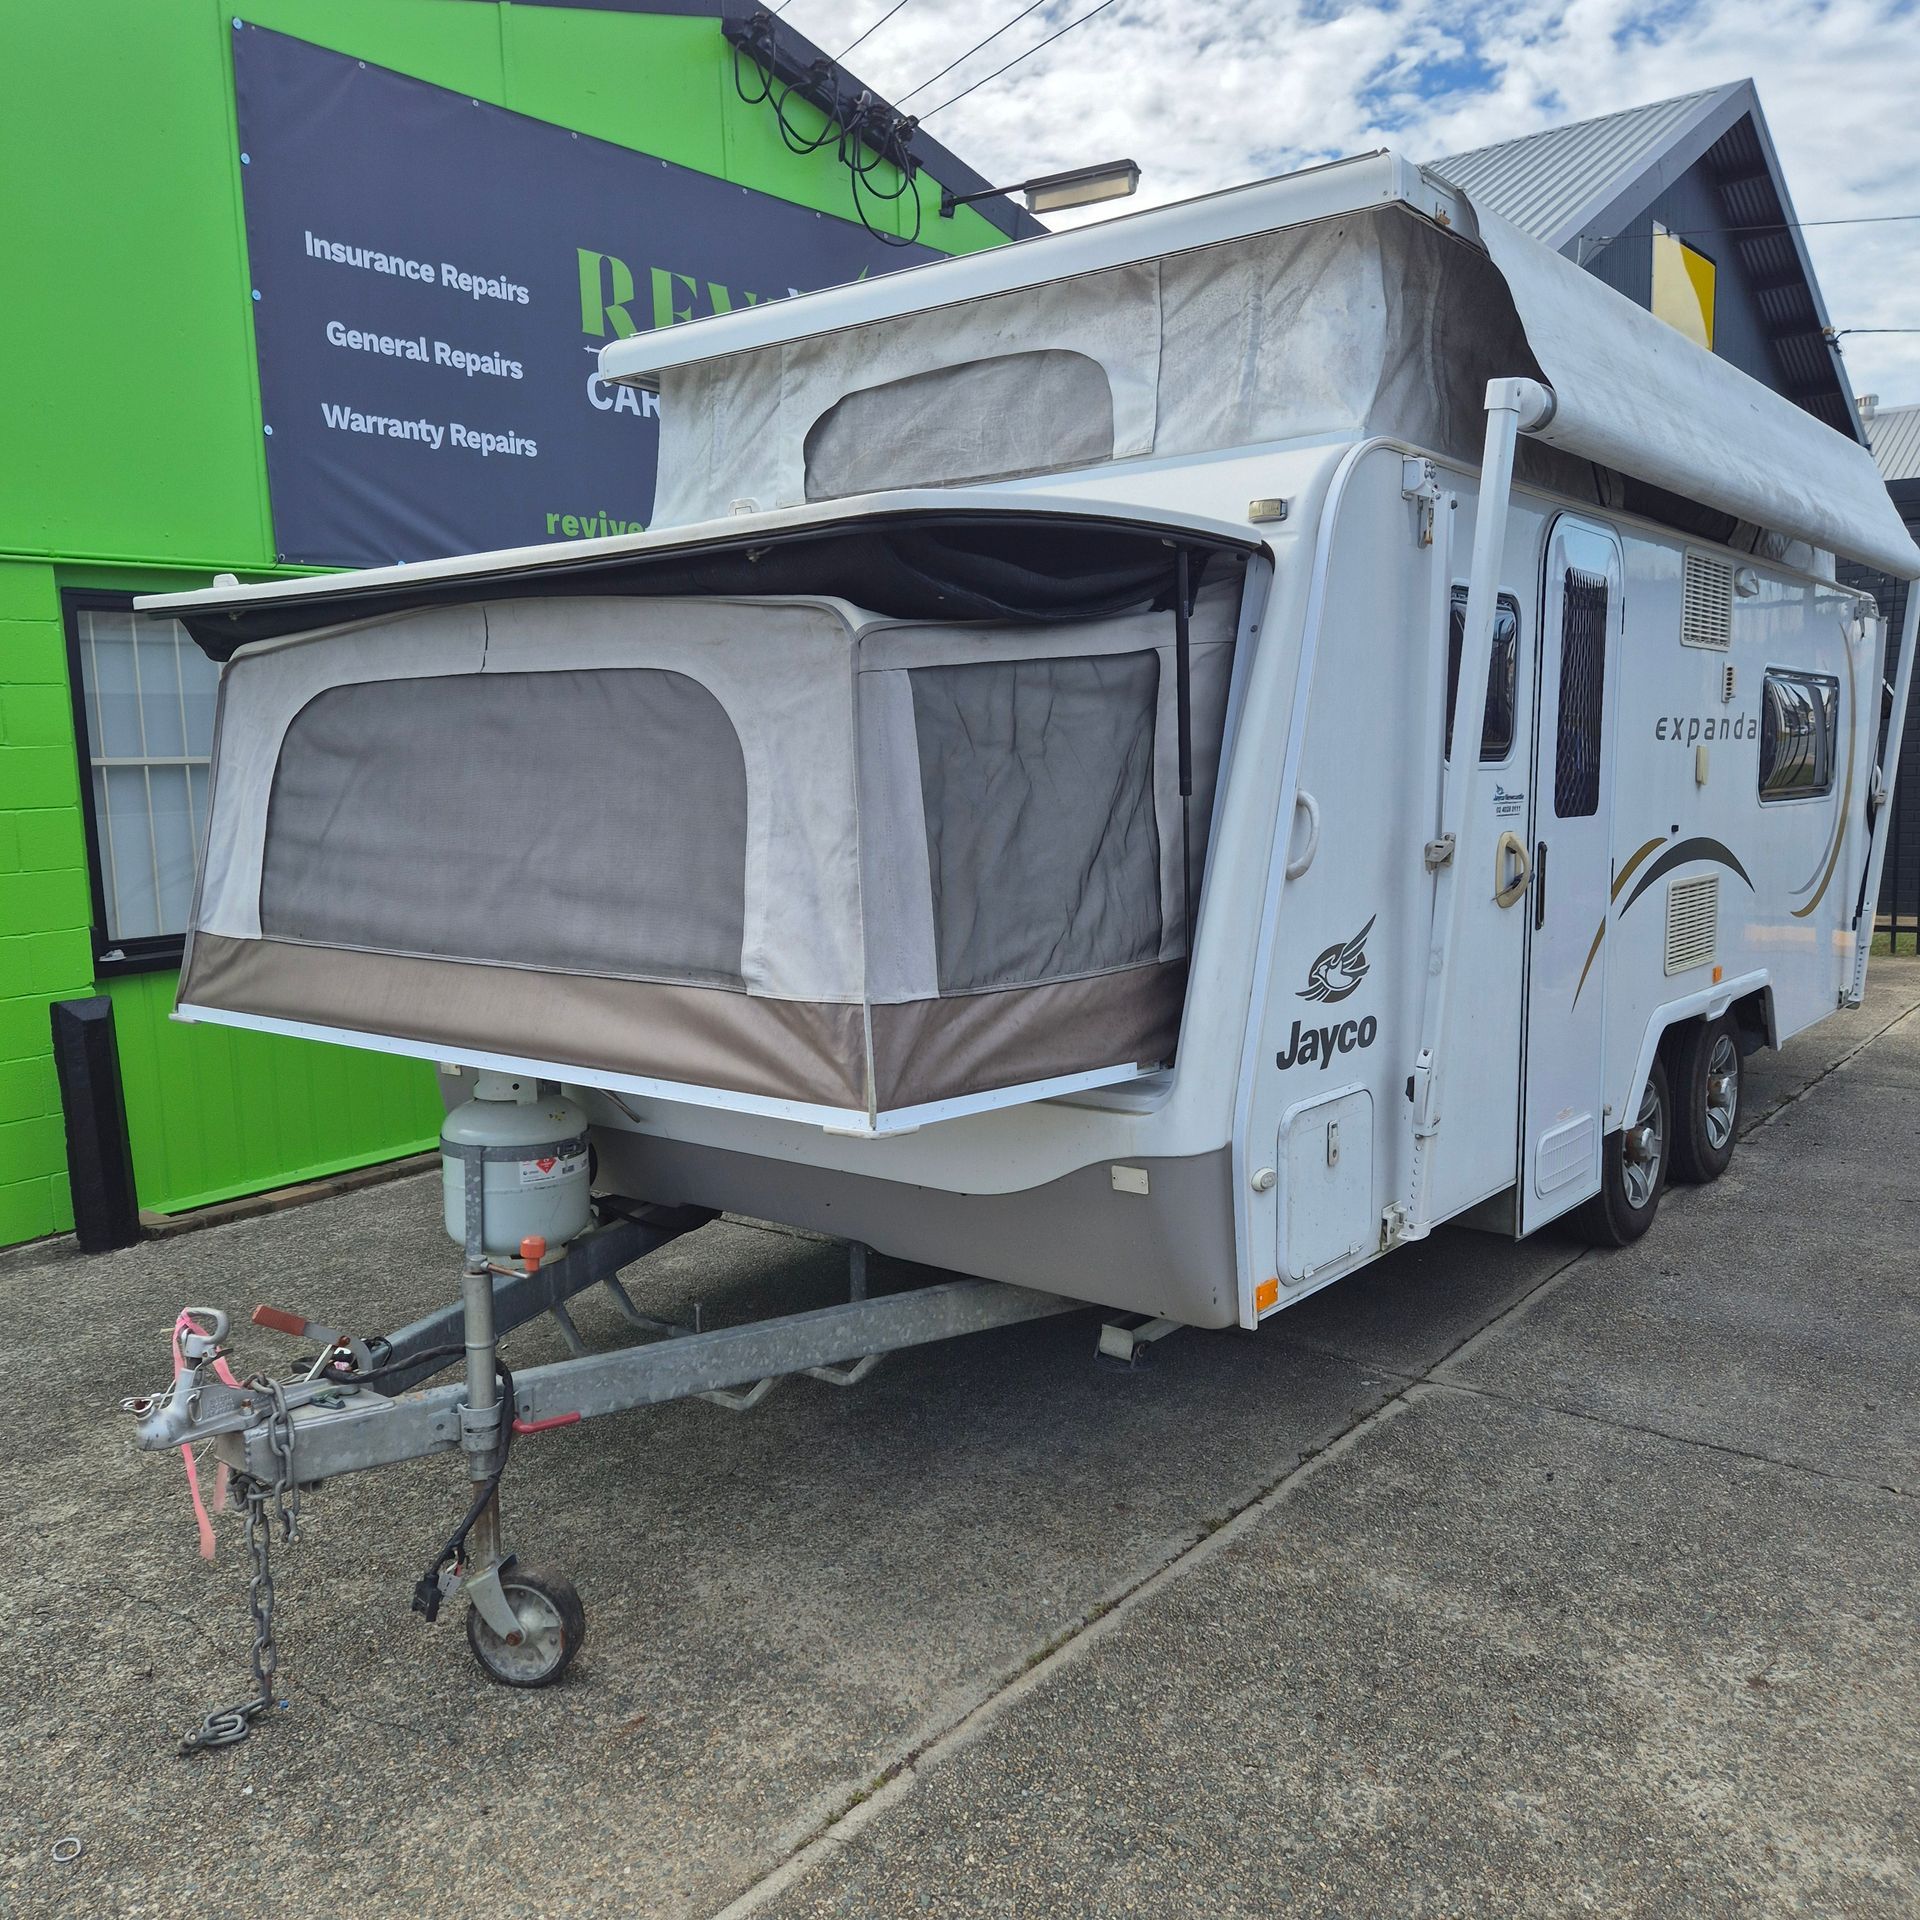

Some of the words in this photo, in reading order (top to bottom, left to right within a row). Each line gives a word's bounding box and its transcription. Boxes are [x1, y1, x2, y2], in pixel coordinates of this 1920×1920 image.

[305, 230, 435, 283] Insurance
[441, 262, 530, 305] Repairs
[326, 320, 430, 362] General
[434, 341, 524, 380] Repairs
[321, 403, 444, 450] Warranty
[450, 423, 538, 458] Repairs
[1655, 712, 1758, 748] expanda
[1276, 1015, 1377, 1070] Jayco
